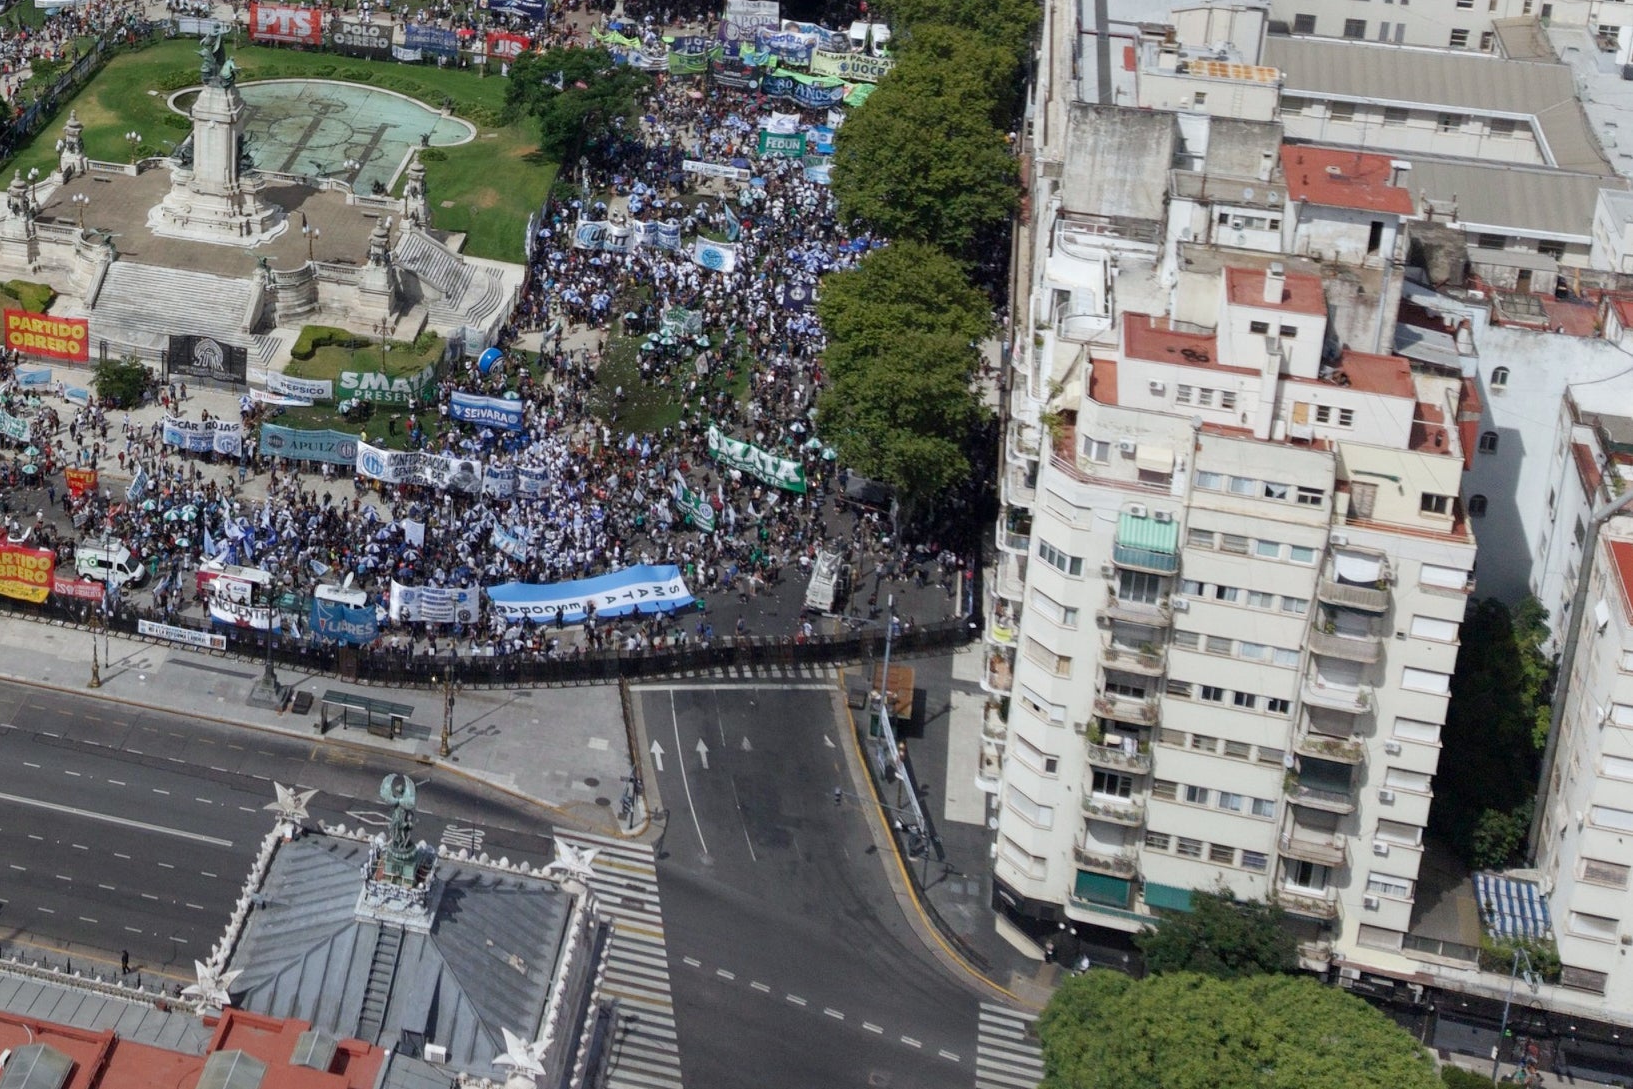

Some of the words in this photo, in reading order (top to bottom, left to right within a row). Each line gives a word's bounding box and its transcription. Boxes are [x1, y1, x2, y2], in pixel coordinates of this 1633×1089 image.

[258, 7, 314, 37] PTS
[343, 23, 381, 37] POLO
[333, 33, 389, 49] OBRERO
[494, 40, 523, 54] JIS
[850, 55, 879, 65] PASO
[8, 315, 85, 340] PARTIDO
[9, 332, 80, 354] OBRERO
[280, 382, 325, 395] PEPSICO
[463, 408, 509, 423] SEIVARA
[205, 419, 240, 432] ROJAS
[605, 584, 681, 605] SMATA
[328, 619, 375, 636] LIBRES
[440, 824, 486, 851] BUS
